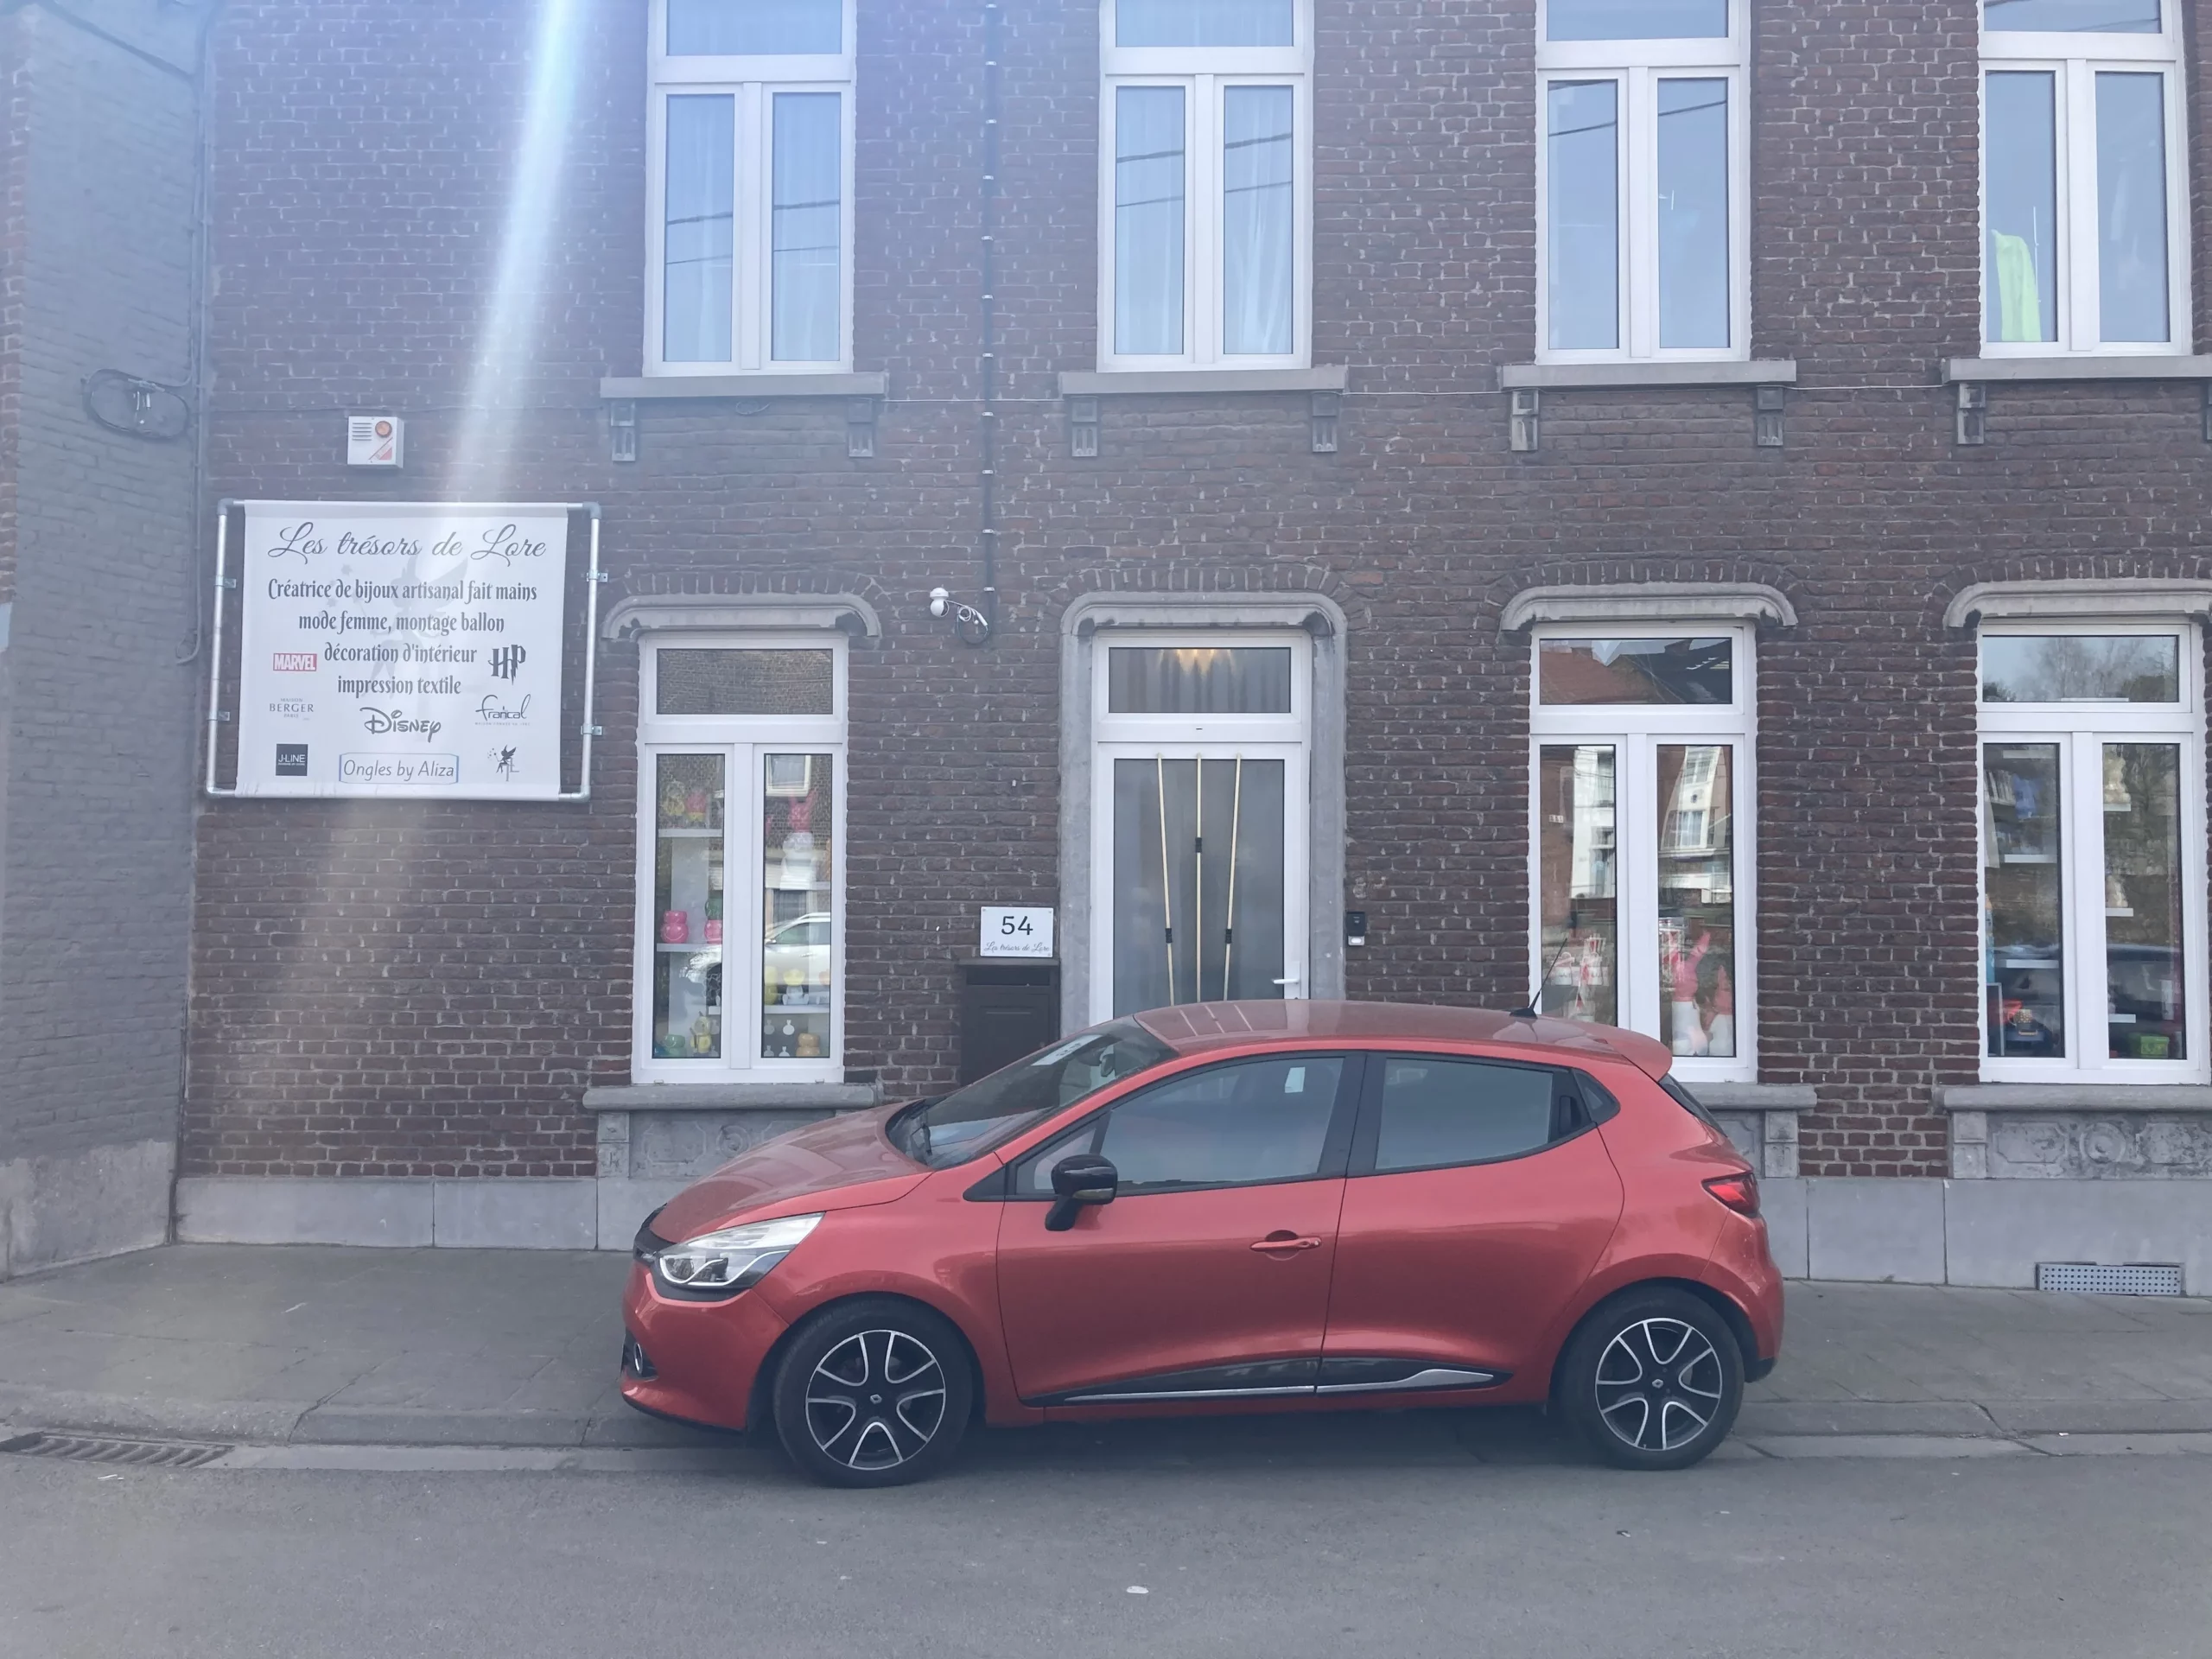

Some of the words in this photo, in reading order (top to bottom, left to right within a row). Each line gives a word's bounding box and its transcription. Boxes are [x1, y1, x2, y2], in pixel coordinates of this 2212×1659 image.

[267, 521, 328, 565] Les
[337, 531, 423, 556] trésors
[431, 531, 463, 556] de
[470, 524, 547, 567] Lore
[268, 578, 332, 600] Créatrice
[334, 578, 352, 598] de
[355, 579, 399, 604] bijoux
[402, 580, 464, 601] artisanal
[464, 580, 493, 605] fait
[495, 582, 537, 602] mains
[298, 610, 337, 630] mode
[336, 610, 391, 635] femme,
[396, 613, 457, 637] montage
[461, 612, 505, 632] ballon
[273, 653, 317, 671] MARVEL
[324, 641, 399, 664] décoration
[402, 642, 478, 664] d'intérieur
[487, 644, 526, 686] HP
[337, 675, 413, 699] impression
[416, 675, 461, 695] textile
[269, 702, 314, 713] BERGER
[277, 753, 306, 763] J-LINE
[343, 759, 392, 781] Ongles
[397, 760, 414, 782] by
[417, 760, 454, 777] Aliza
[1001, 915, 1033, 936] 54
[1021, 943, 1031, 951] de
